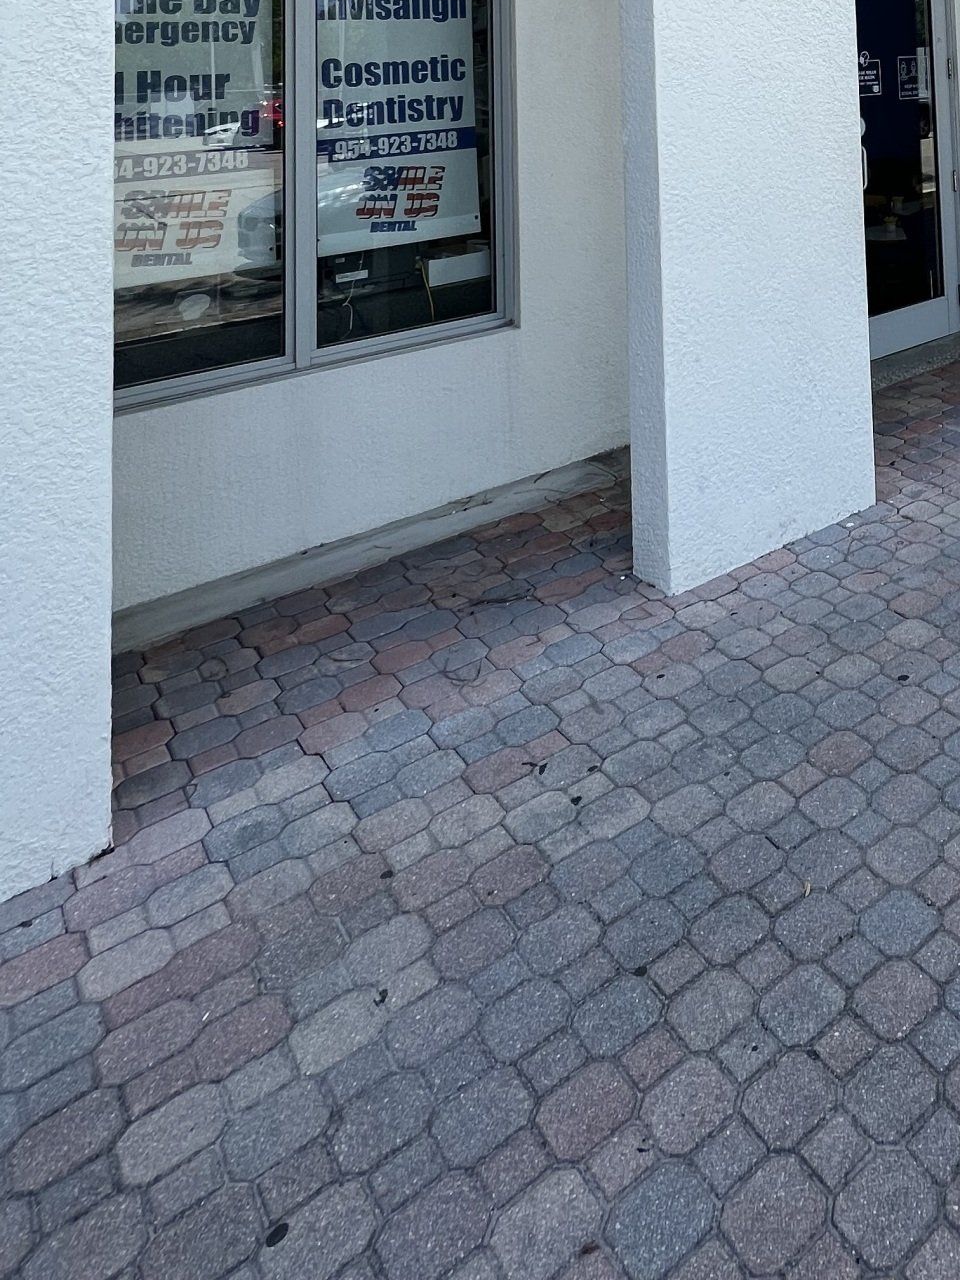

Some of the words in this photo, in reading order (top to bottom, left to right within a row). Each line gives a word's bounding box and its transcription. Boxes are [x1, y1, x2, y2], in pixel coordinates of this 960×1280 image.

[115, 20, 256, 47] ergency
[321, 54, 466, 89] Cosmetic
[136, 70, 230, 103] Hour
[115, 108, 260, 142] hitening
[323, 95, 464, 129] Dentistry
[335, 131, 457, 159] 954-923-7348
[363, 166, 445, 191] SMILE
[121, 189, 232, 219] SMILE
[176, 220, 224, 249] US
[131, 252, 193, 267] DENTAL
